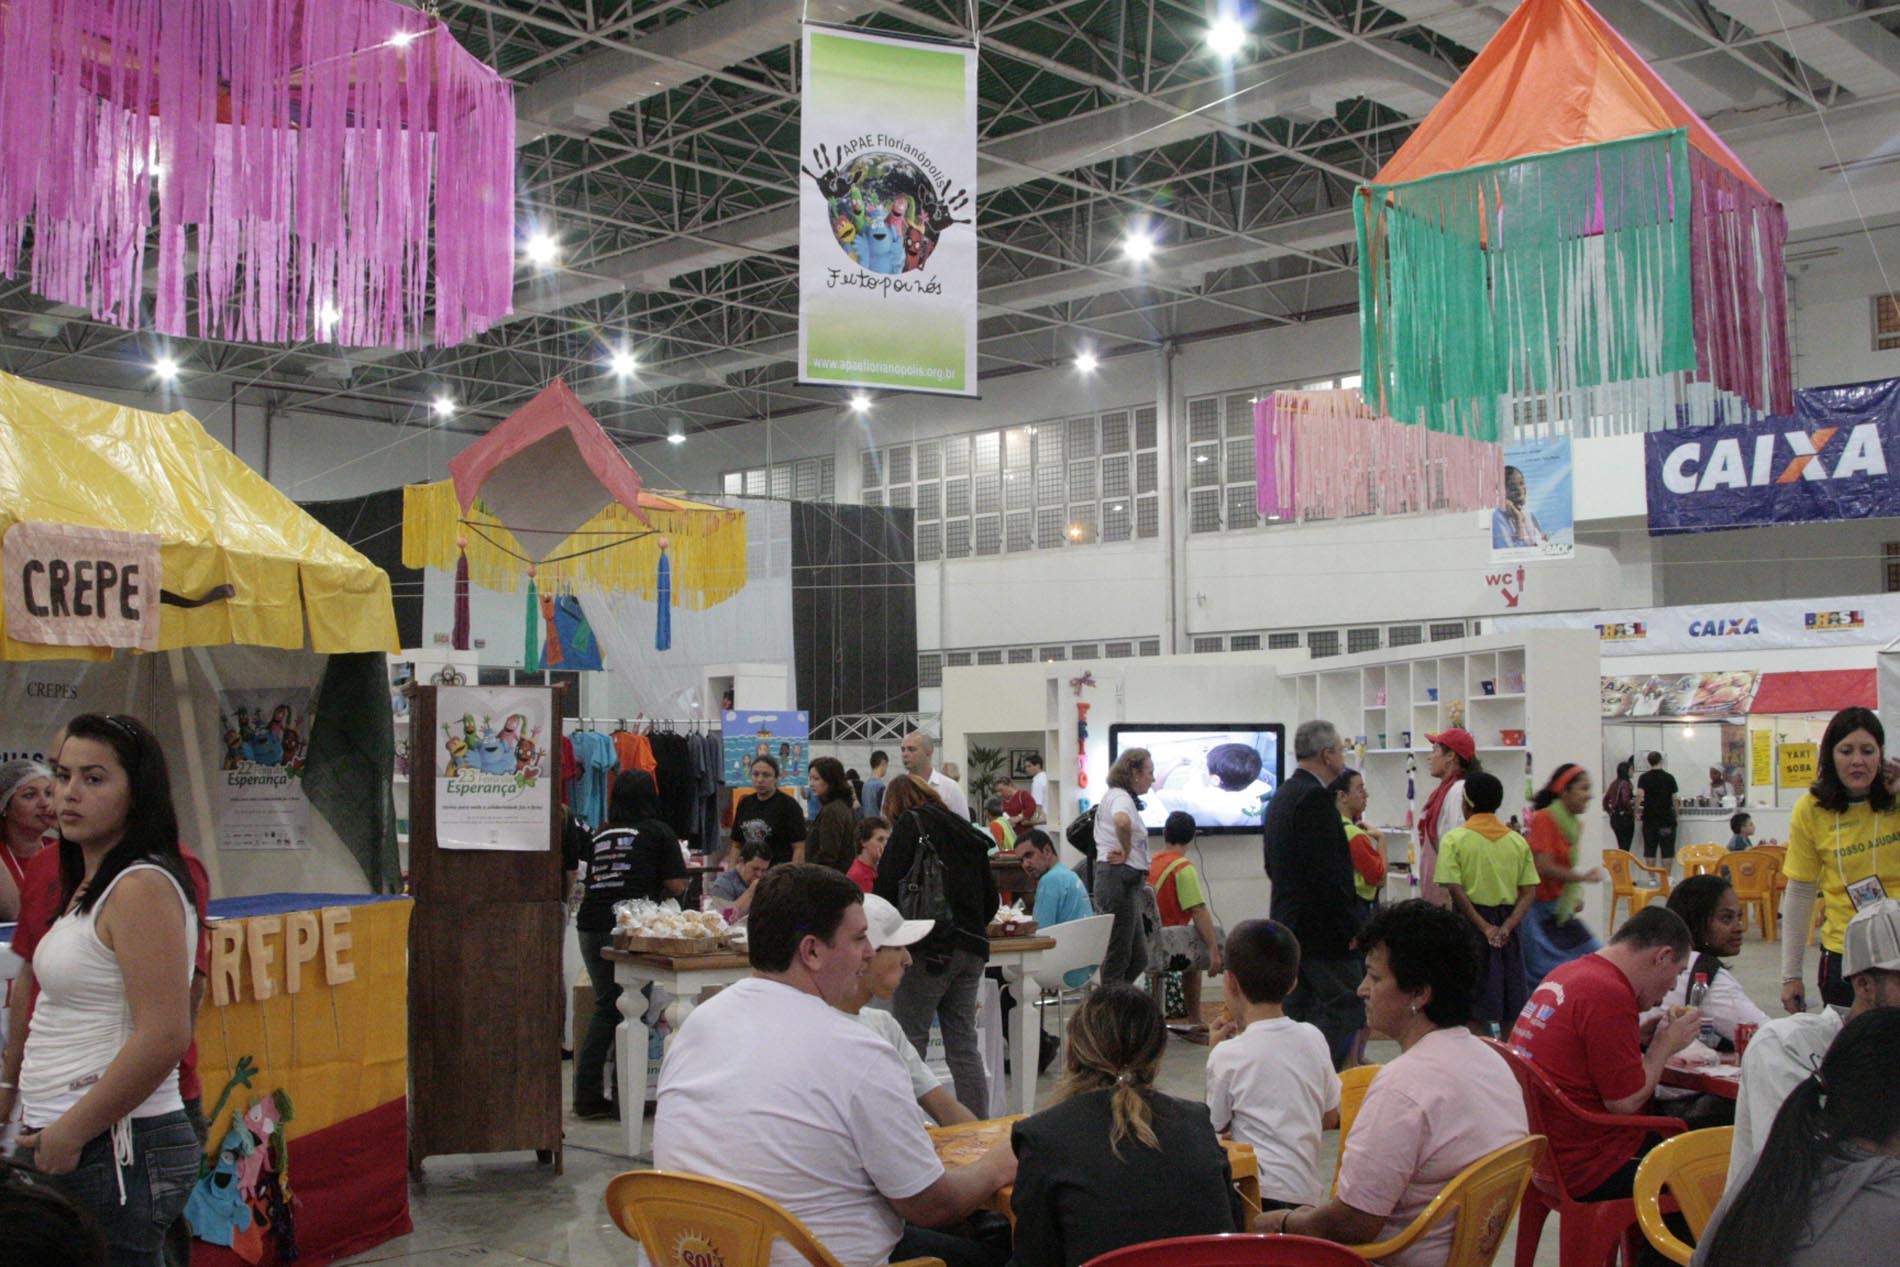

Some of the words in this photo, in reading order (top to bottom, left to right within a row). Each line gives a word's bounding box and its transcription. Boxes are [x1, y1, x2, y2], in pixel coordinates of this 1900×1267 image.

[843, 134, 874, 157] APAE
[877, 134, 945, 188] Florianópolis
[1662, 423, 1889, 495] CAIXA
[1485, 573, 1512, 586] WC
[23, 559, 140, 621] CREPE
[1688, 618, 1760, 638] CAIXA
[27, 682, 77, 699] CREPES
[228, 772, 287, 789] Esperança
[459, 769, 477, 783] 23
[447, 780, 516, 798] Esperança
